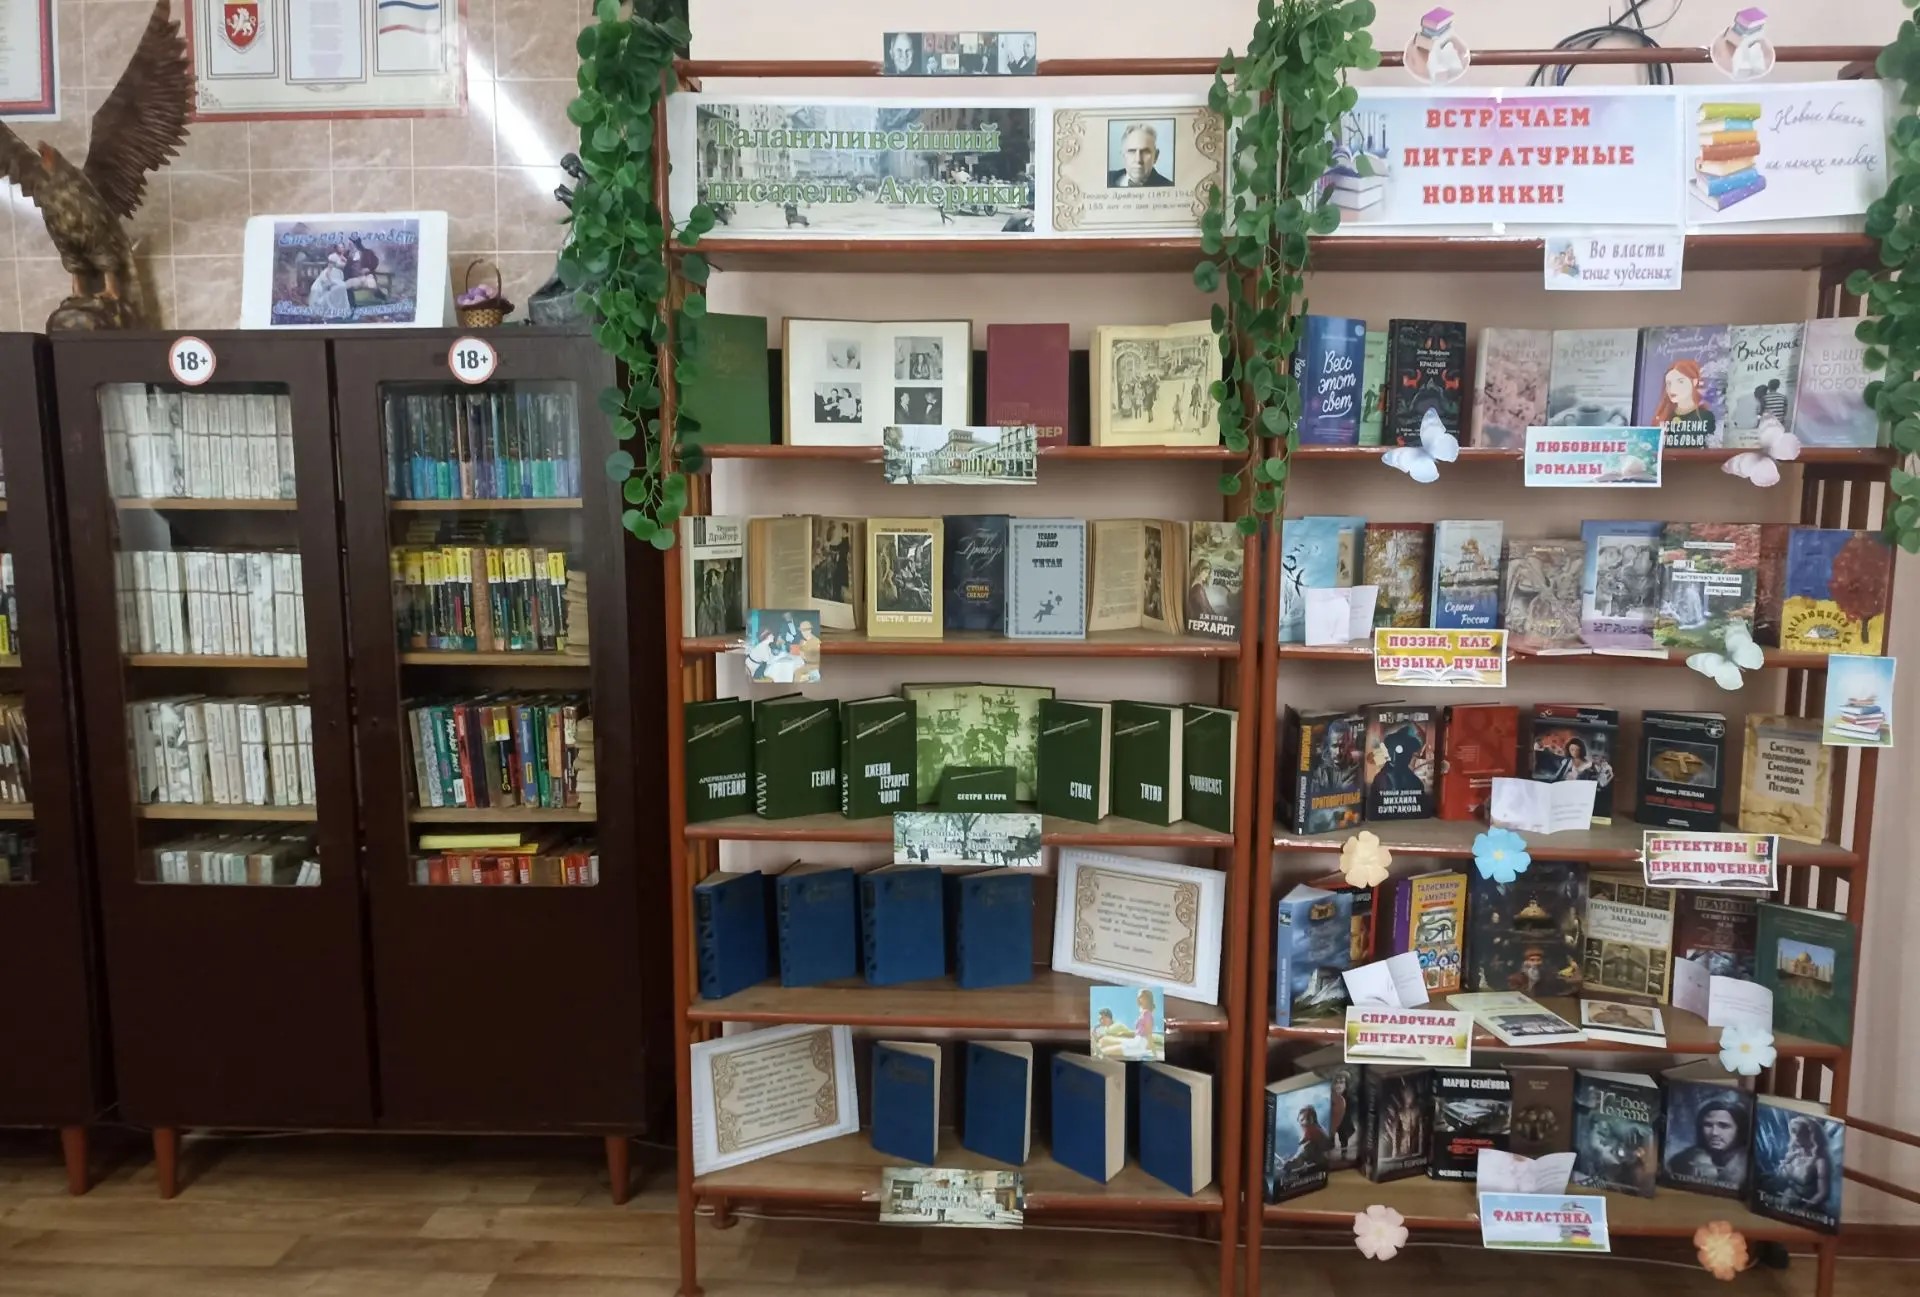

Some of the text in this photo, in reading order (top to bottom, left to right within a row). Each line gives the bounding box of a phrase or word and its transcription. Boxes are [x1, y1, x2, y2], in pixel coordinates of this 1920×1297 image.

[1425, 107, 1591, 129] ВСТРЕЧАЕМ
[709, 115, 1002, 153] Талантливейший
[1403, 144, 1635, 167] ЛИТЕРАТУРНЫЕ
[706, 175, 1030, 212] писатель Америки
[1422, 183, 1565, 205] НОВИНКИ!
[1588, 240, 1666, 260] Во власти
[1581, 264, 1673, 284] книг чудесных
[176, 350, 209, 371] 18+
[456, 349, 489, 370] 18+
[1322, 350, 1353, 374] Весь
[1811, 362, 1866, 376] ТОЛЬК
[1318, 373, 1357, 396] этот
[1319, 391, 1354, 417] свет
[1535, 441, 1626, 453] ЛЮБОВНЫЕ
[1535, 463, 1603, 474] РОМАНЫ
[1031, 558, 1063, 568] ТИТАН
[1188, 619, 1236, 636] ГЕРХАРДТ
[1460, 613, 1490, 625] России
[1388, 636, 1492, 649] ПОЭЗИЯ, КАК
[1379, 656, 1500, 670] МУЗЫКА ДУШИ
[698, 771, 747, 784] АМЕРИКАНСКАЯ
[810, 767, 837, 788] ГЕНИЙ
[864, 761, 892, 778] ДЖЕННИ
[880, 772, 910, 790] ГЕРХАРДТ
[707, 780, 747, 800] ТРАГЕДИЯ
[957, 793, 1007, 801] СЕСТРА КЕРРИ
[1069, 781, 1092, 800] СТОИК
[1140, 782, 1163, 802] ТИТАН
[1377, 804, 1422, 814] БУЛГАКОВА
[1383, 796, 1418, 805] МИХАИЛА
[1652, 840, 1769, 853] ДЕТЕКТИВЫ И
[1651, 861, 1768, 875] ПРИКЛЮЧЕНИЯ
[1417, 881, 1461, 893] ТАЛИСМАНЫ
[1590, 902, 1669, 921] ПОУЧИТЕЛЬНЫЕ
[1610, 913, 1648, 926] ЗАБАВЫ
[1361, 1013, 1456, 1027] СПРАВОЧНАЯ
[1359, 1032, 1455, 1046] ЛИТЕРАТУРА
[1442, 1077, 1511, 1091] МАРИЯ СЕМЁНОВА
[1493, 1209, 1593, 1225] ФАНТАСТИКА
